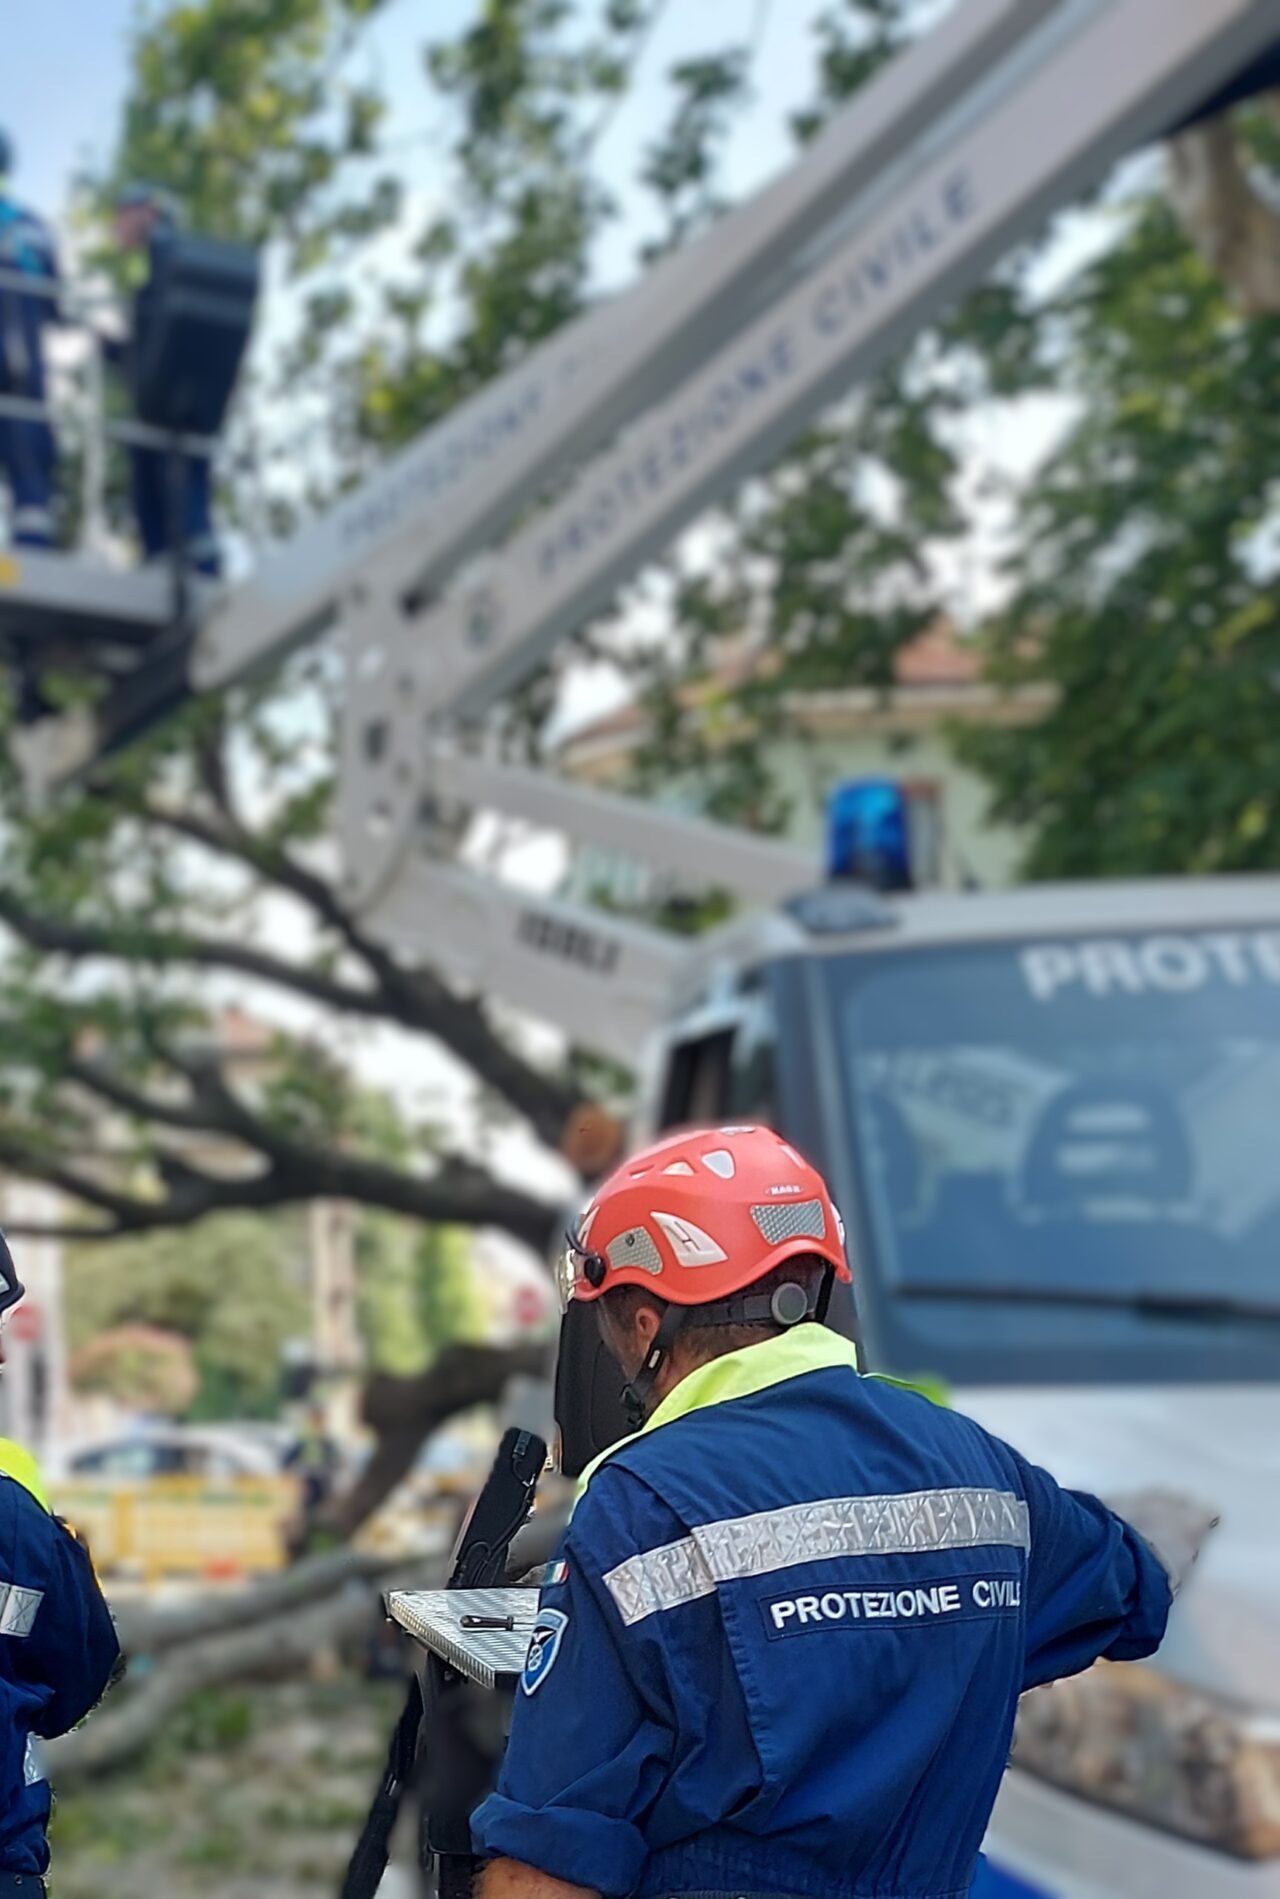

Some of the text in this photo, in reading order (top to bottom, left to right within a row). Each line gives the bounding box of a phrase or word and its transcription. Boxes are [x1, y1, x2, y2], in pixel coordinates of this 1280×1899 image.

[538, 168, 976, 578] PROTEZIONE CIVILE
[770, 1585, 961, 1629] PROTEZIONE
